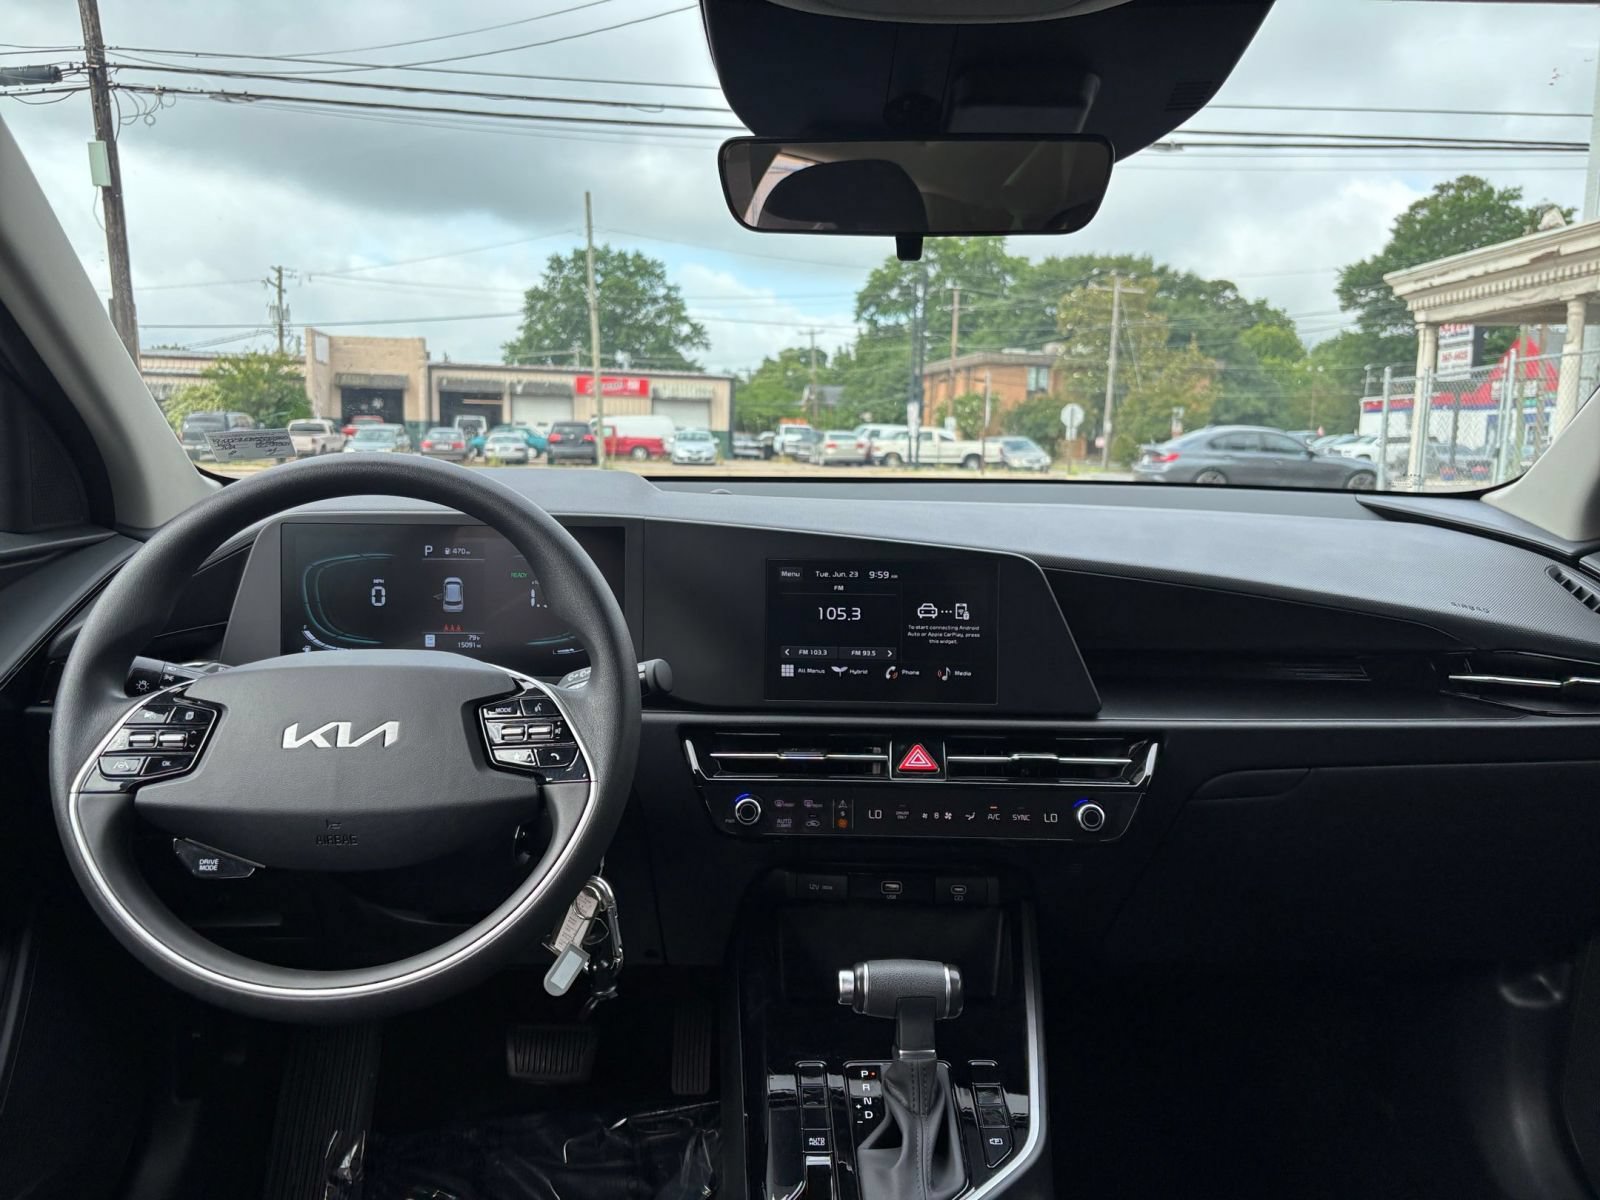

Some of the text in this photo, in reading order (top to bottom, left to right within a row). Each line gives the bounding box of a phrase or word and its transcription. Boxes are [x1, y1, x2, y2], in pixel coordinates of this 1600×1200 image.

[425, 545, 433, 556] P
[372, 586, 386, 606] 0
[818, 607, 861, 621] 105.3
[282, 720, 400, 748] KIA
[868, 810, 882, 819] LO
[1044, 814, 1058, 822] LO
[864, 1111, 874, 1119] D
